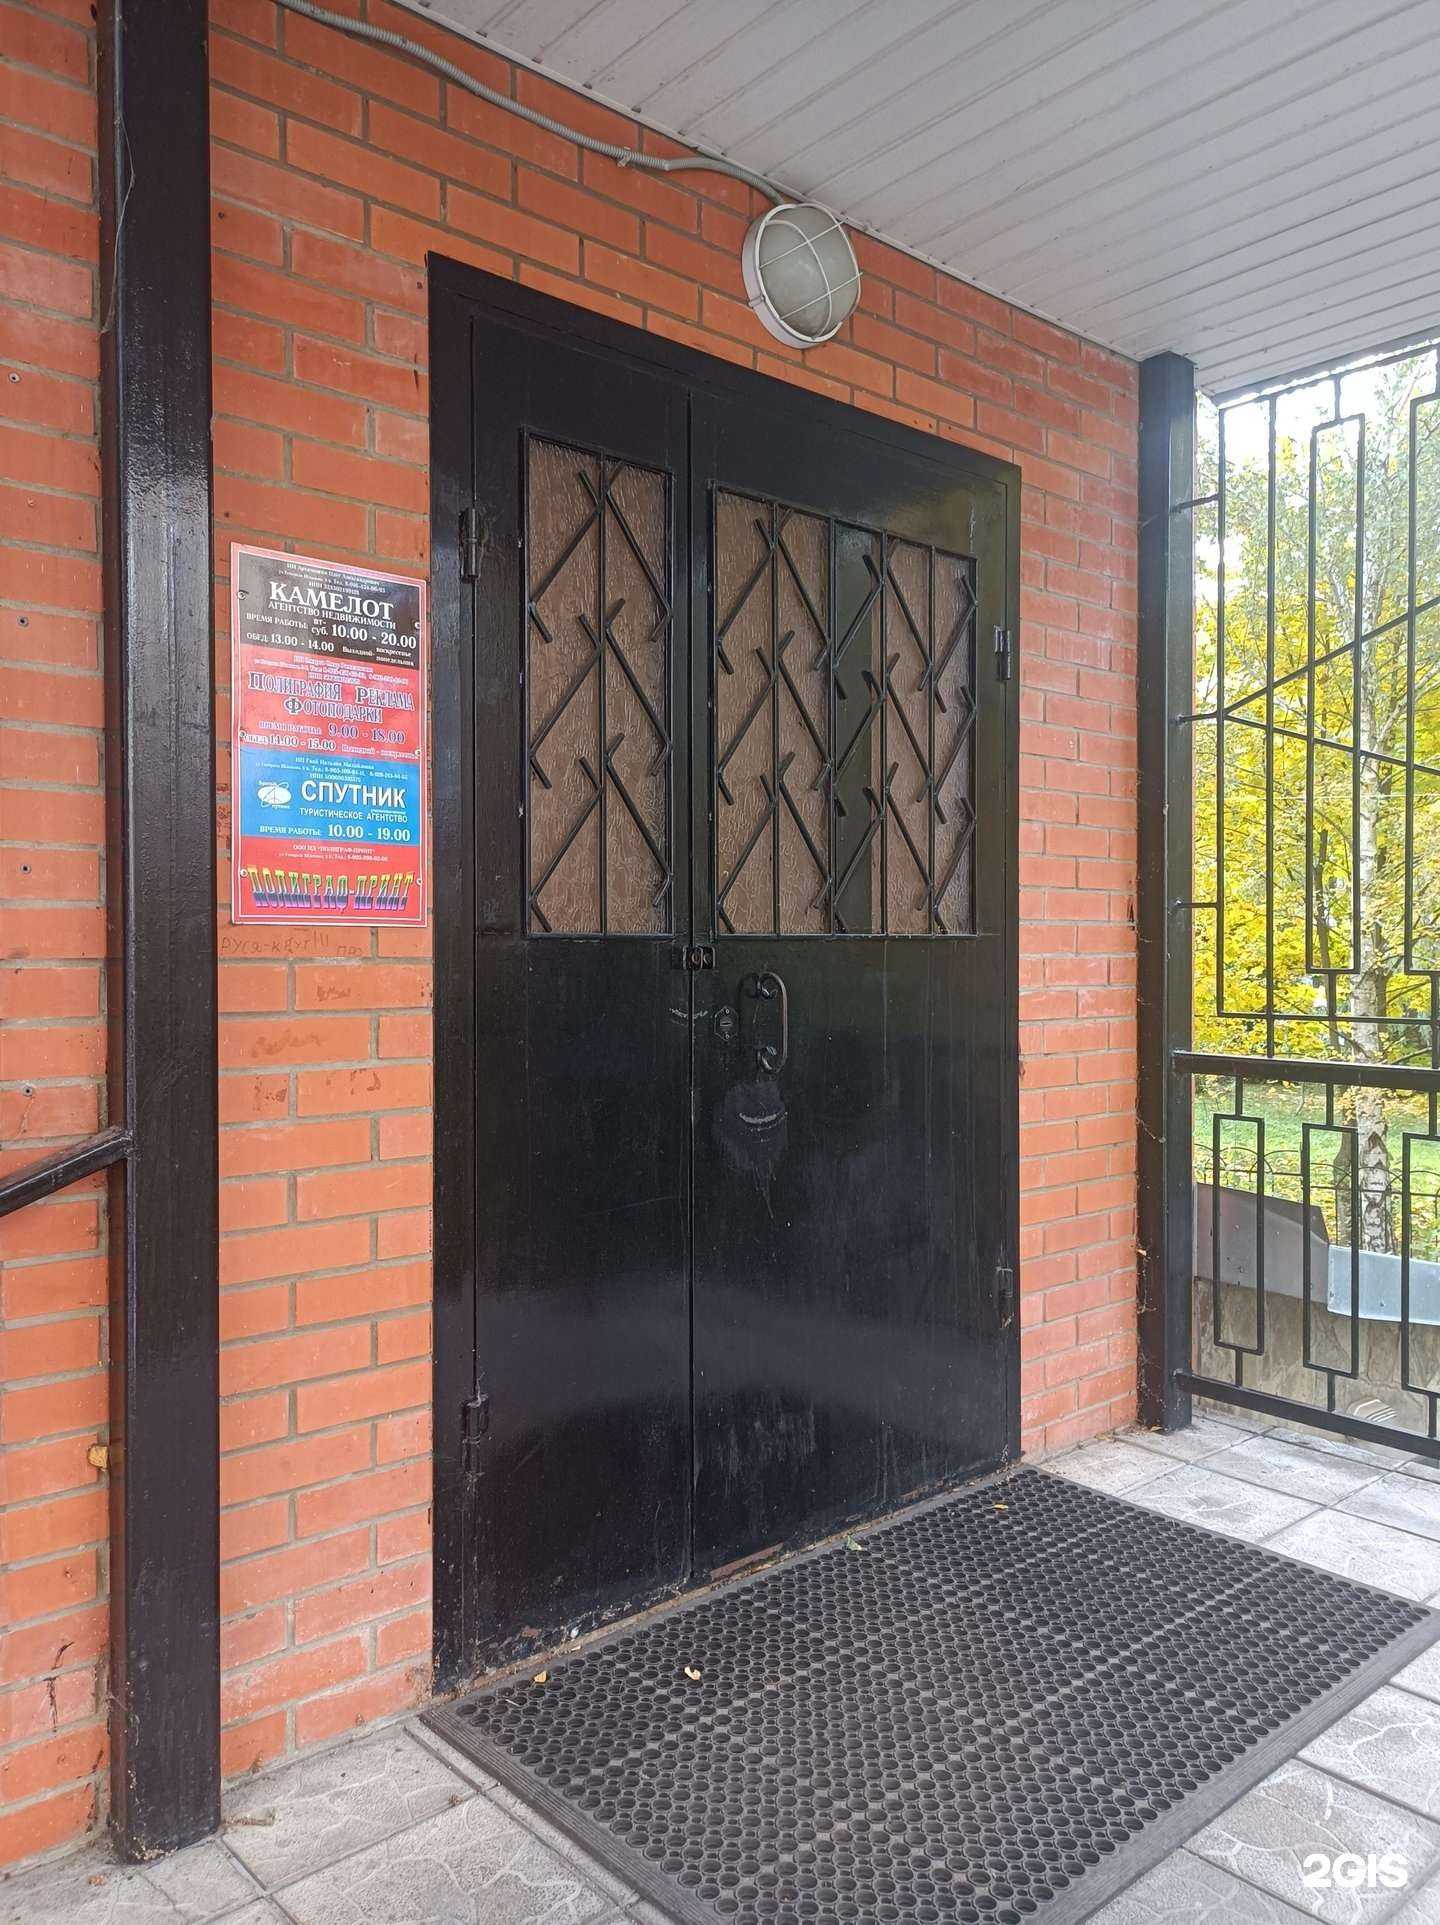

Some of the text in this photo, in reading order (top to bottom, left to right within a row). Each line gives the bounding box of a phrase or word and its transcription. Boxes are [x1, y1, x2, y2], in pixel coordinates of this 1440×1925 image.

[269, 581, 394, 621] КАМЕЛОТ
[246, 612, 273, 624] ВРЕМЯ
[268, 601, 396, 630] АГЕНТСТВО НЕДВИЖИМОСТИ
[270, 633, 298, 647] 13.00
[308, 639, 335, 653] 14.00
[331, 624, 368, 642] 10.00
[380, 632, 417, 649] 20.00
[249, 672, 342, 701] ПОЛИГРАФИЯ
[355, 686, 415, 711] РЕКЛАМА
[284, 697, 383, 723] ФОТОПОДАРКИ
[308, 737, 336, 751] 15.00
[328, 722, 358, 739] 9.00
[371, 729, 406, 745] 18.00
[301, 780, 407, 808] СПУТНИК
[299, 808, 363, 820] ТУРИСТИЧЕСКОЕ
[367, 812, 408, 824] АГЕНТСТВО
[259, 825, 286, 834] ВРЕМЯ
[328, 824, 364, 838] 10.00
[377, 827, 411, 842] 19.00
[247, 866, 415, 911] ПОЛИГРАФ-ПРИНТ
